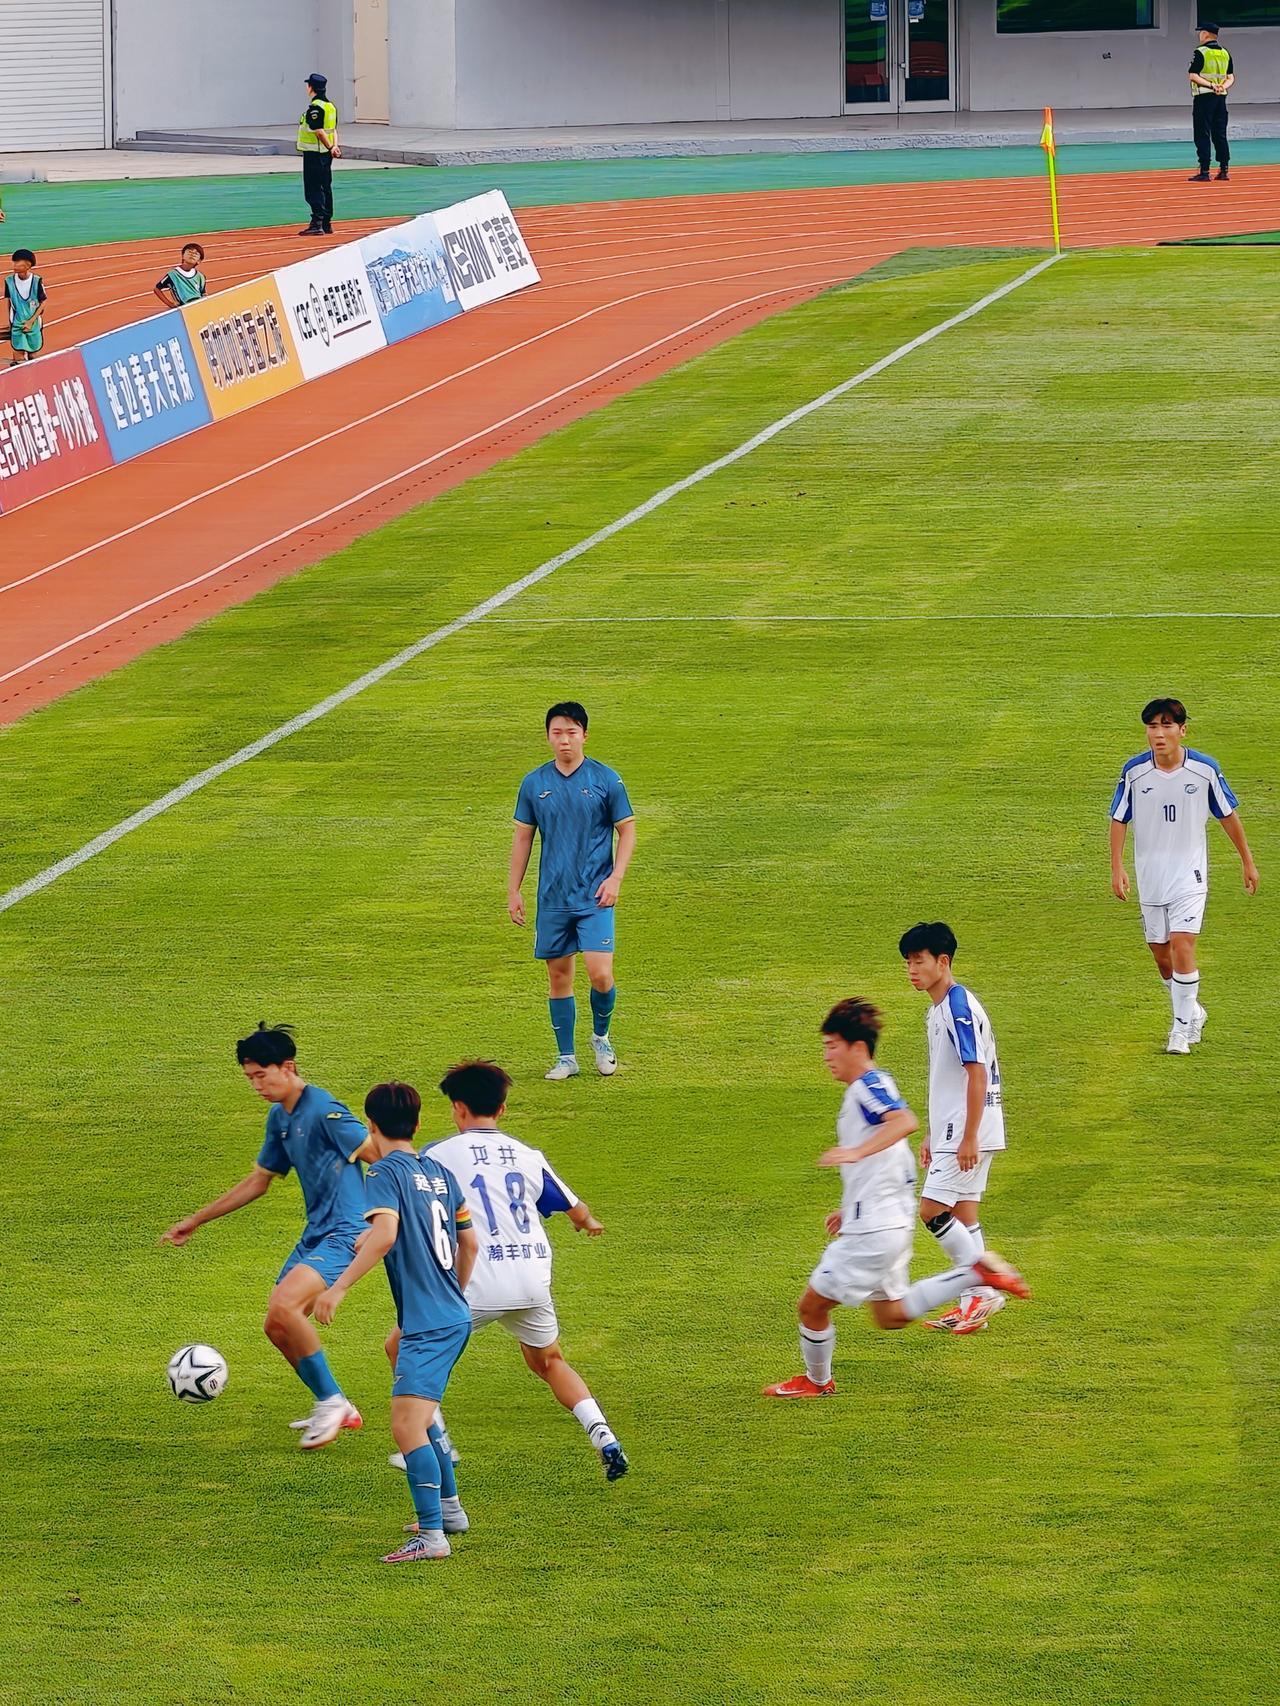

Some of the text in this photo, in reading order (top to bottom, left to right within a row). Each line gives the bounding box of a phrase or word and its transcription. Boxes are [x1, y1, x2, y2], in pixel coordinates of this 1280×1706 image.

[293, 301, 318, 341] ICBC
[323, 278, 367, 328] 中国工商银行
[101, 336, 195, 430] 延边春天传媒
[1163, 804, 1176, 822] 10
[413, 1173, 448, 1195] 延吉
[470, 1172, 530, 1236] 18
[431, 1200, 453, 1270] 6
[487, 1242, 547, 1261] 瀚丰矿业
